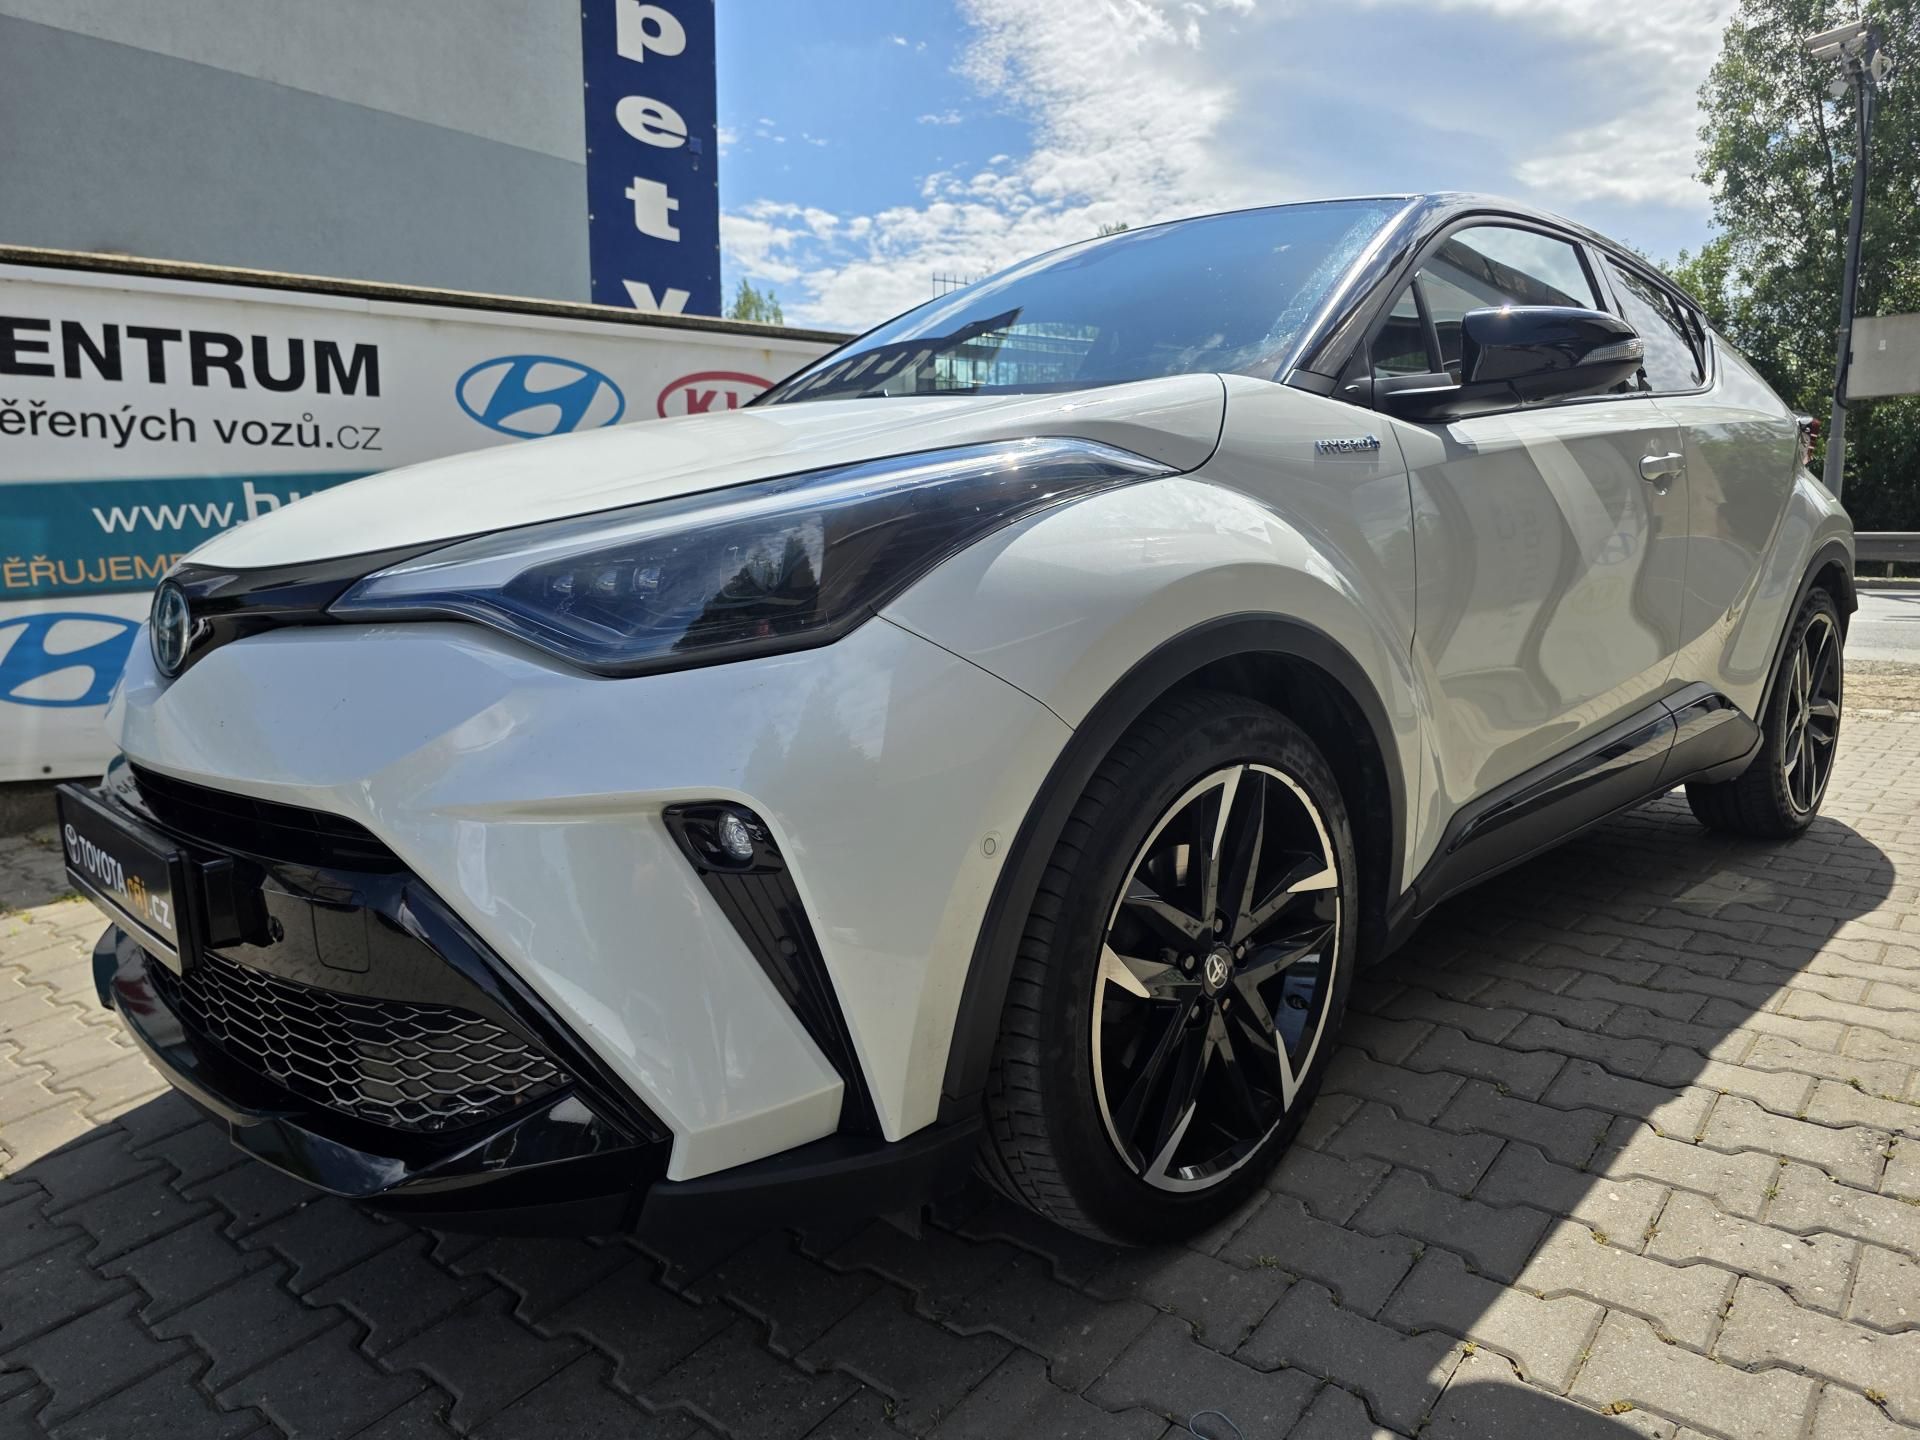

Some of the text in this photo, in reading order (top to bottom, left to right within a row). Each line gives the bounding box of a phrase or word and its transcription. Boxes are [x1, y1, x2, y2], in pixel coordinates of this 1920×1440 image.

[0, 315, 381, 398] ENTRUM
[0, 398, 383, 451] ěřených vozů.cz
